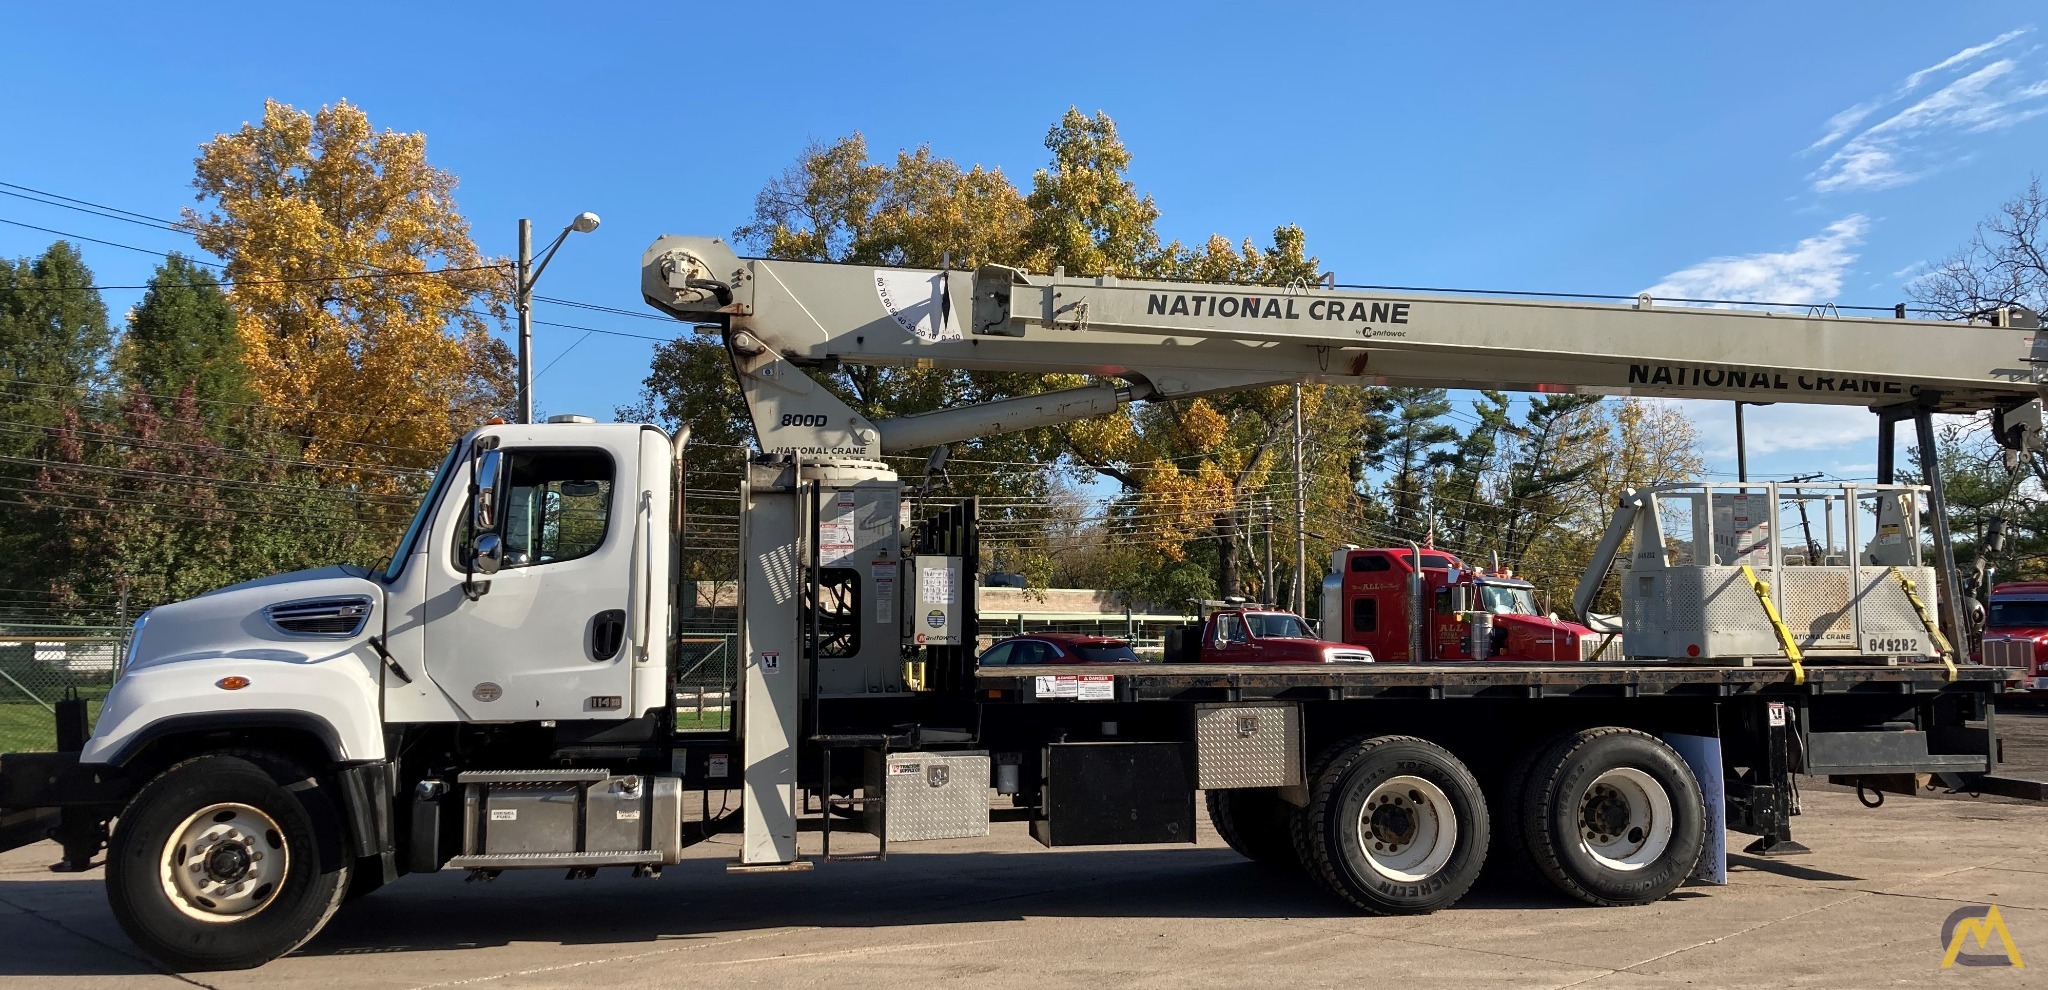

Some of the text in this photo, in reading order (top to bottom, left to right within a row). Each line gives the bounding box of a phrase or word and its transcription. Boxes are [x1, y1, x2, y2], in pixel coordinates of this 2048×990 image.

[876, 277, 884, 287] 80
[879, 288, 887, 298] 70
[883, 298, 892, 308] 60
[889, 307, 899, 317] 50
[1147, 293, 1411, 325] NATIONAL CRANE
[897, 316, 907, 325] 40
[905, 322, 916, 332] 30
[916, 328, 926, 337] 20
[927, 332, 937, 340] 10
[1628, 364, 1789, 390] NATIONAL
[781, 413, 828, 427] 800D
[776, 446, 867, 455] NATONAL CRANE
[1439, 623, 1464, 632] ALL
[592, 698, 610, 708] 114
